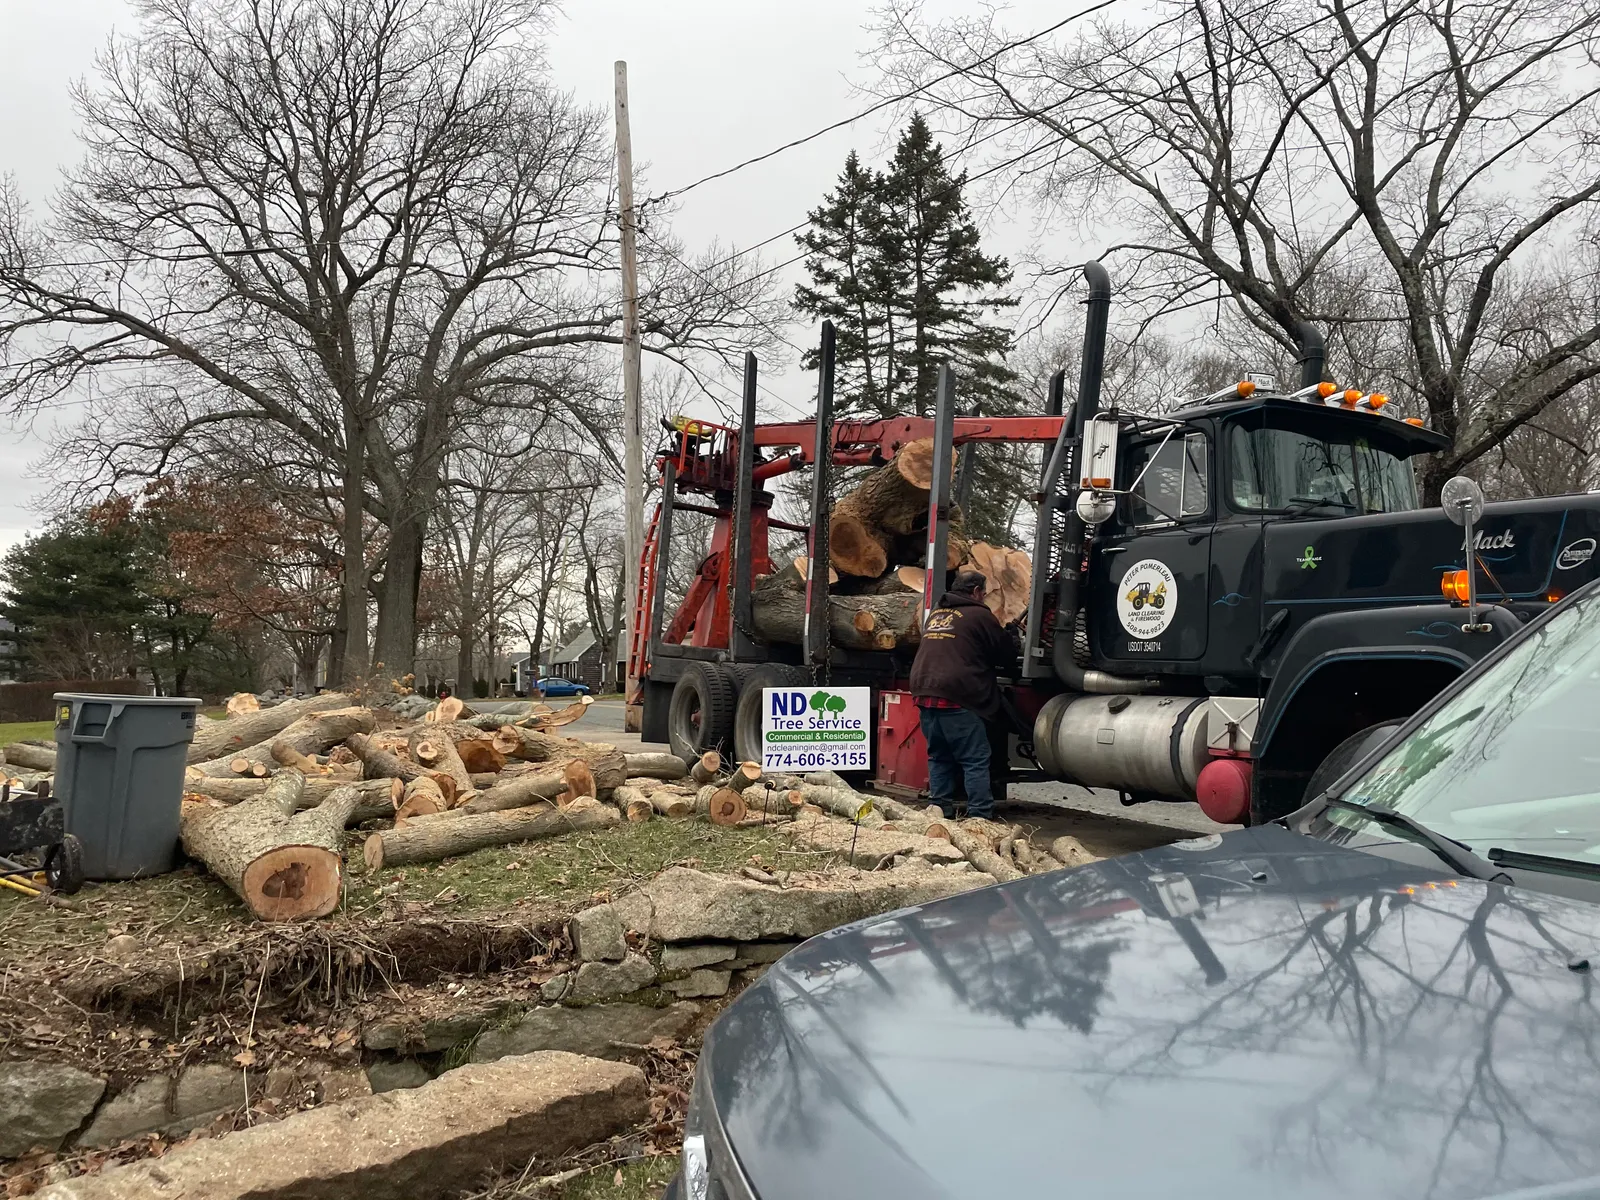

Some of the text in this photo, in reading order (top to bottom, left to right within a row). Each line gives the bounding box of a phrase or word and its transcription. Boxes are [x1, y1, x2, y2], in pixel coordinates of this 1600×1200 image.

[1460, 528, 1516, 551] Mack
[1124, 566, 1140, 586] PETER
[1127, 641, 1143, 652] USDOT
[771, 692, 807, 716] ND
[771, 716, 862, 730] Tree Service
[768, 733, 813, 741] Commercial
[823, 732, 864, 740] Residential
[767, 743, 866, 753] ndcleaninginc@gmail.com
[765, 752, 867, 767] 774-606-3155
